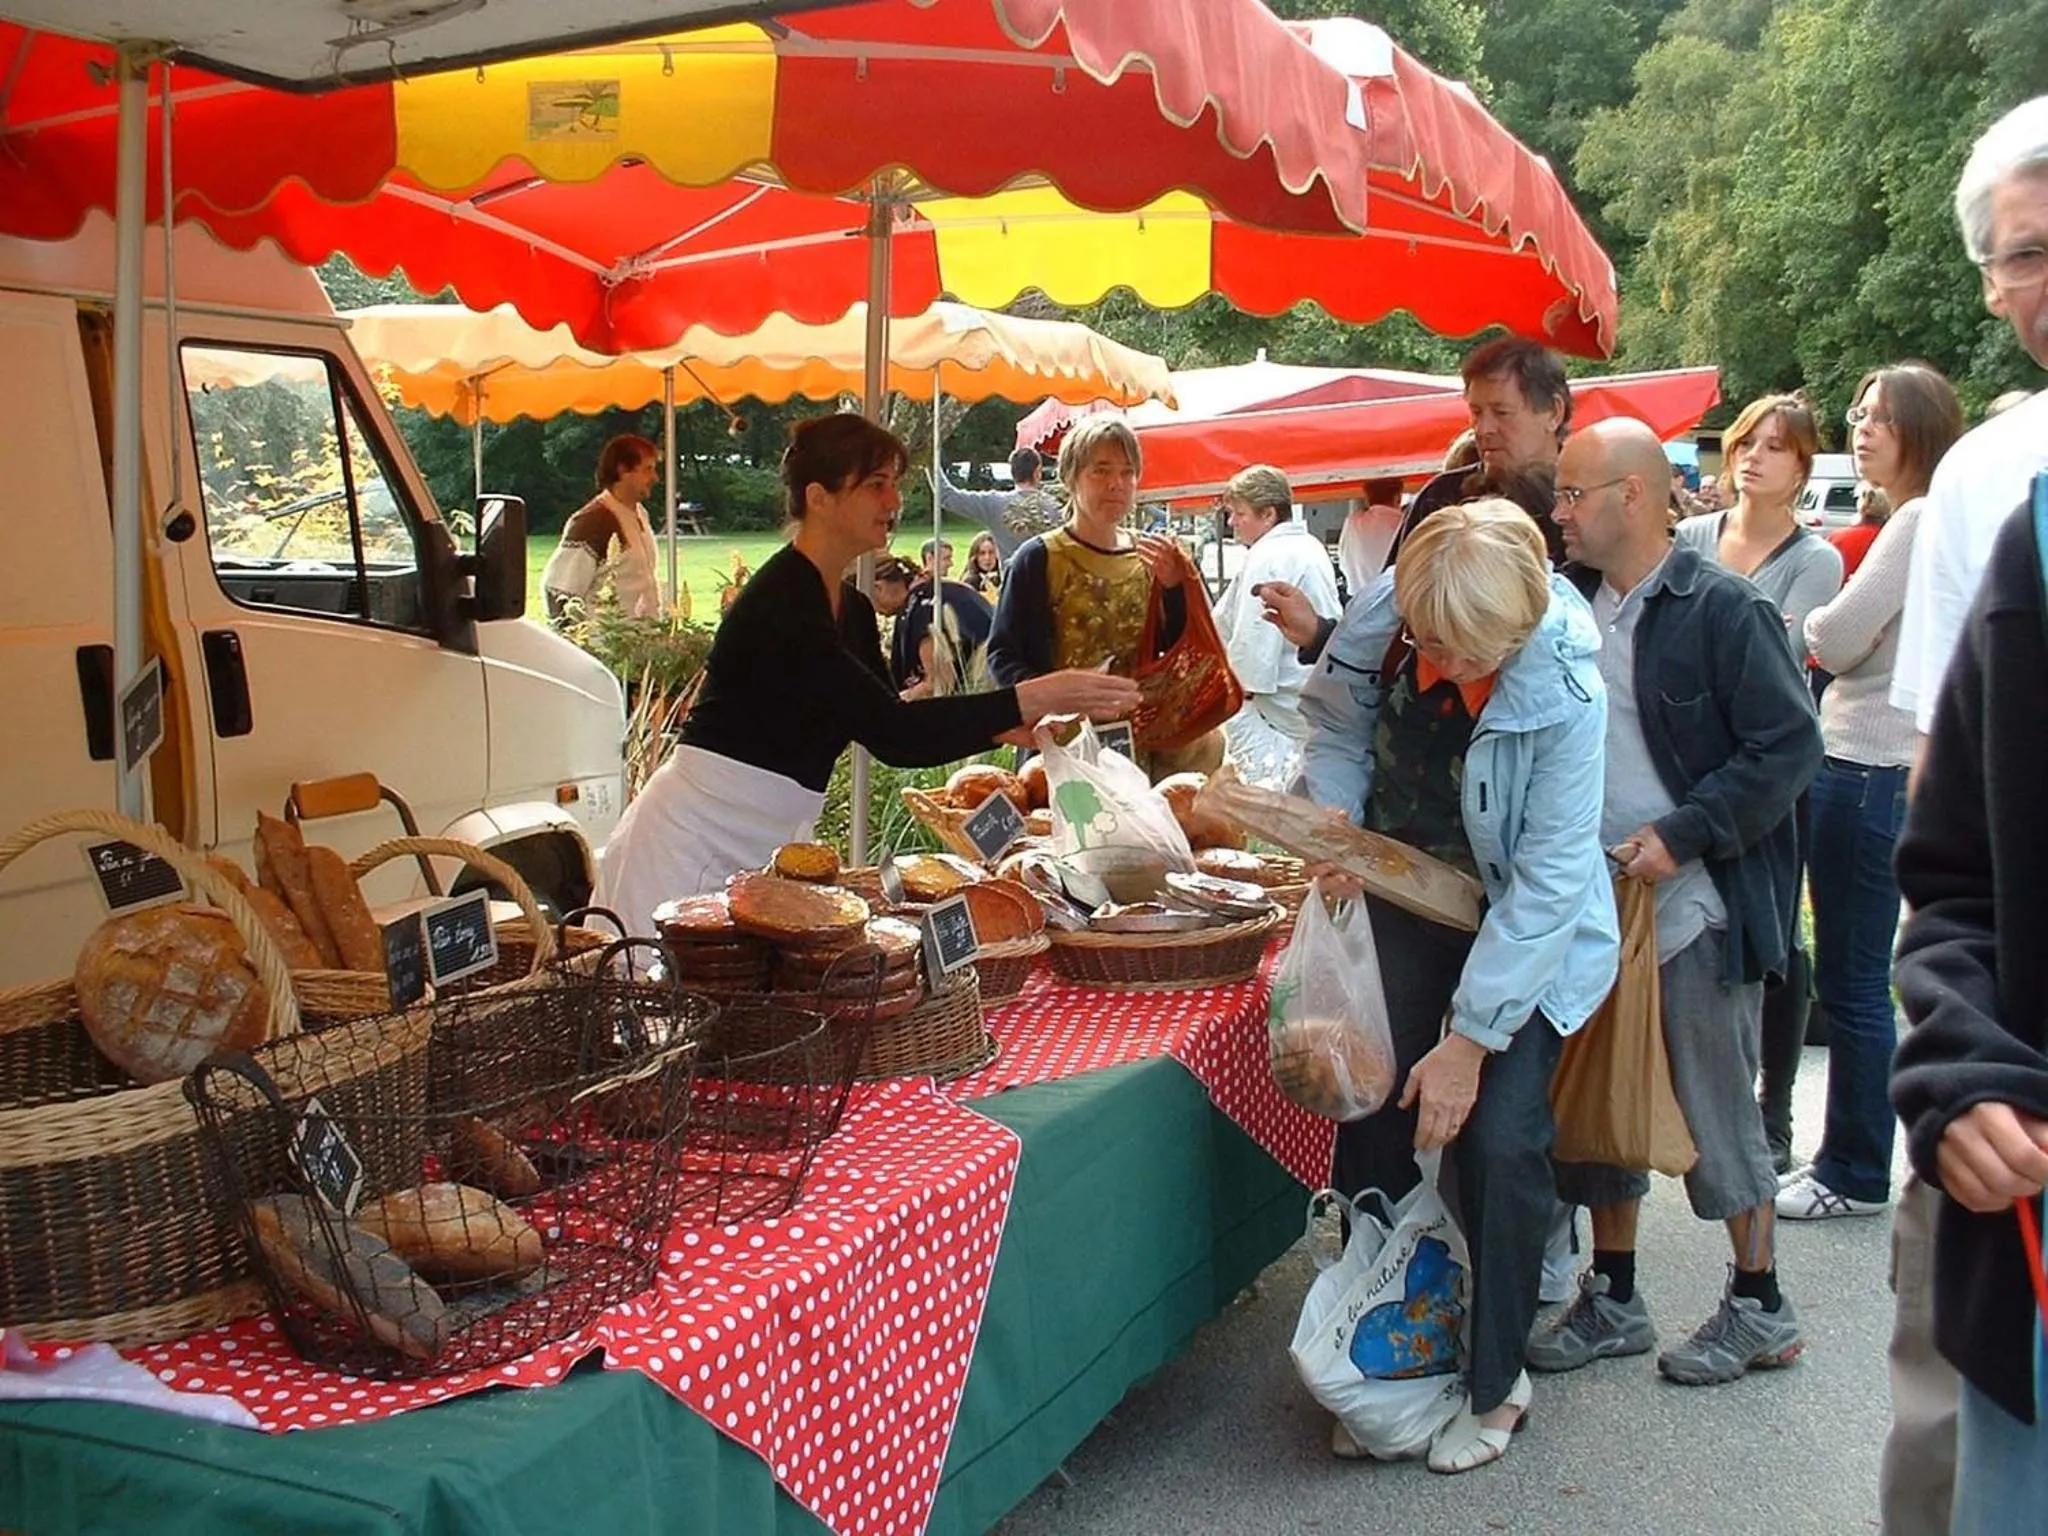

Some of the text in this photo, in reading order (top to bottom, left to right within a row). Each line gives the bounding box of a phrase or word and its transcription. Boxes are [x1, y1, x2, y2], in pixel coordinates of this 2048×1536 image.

[1333, 1325, 1346, 1350] et
[1347, 1298, 1364, 1323] la
[1366, 1247, 1408, 1298] nature
